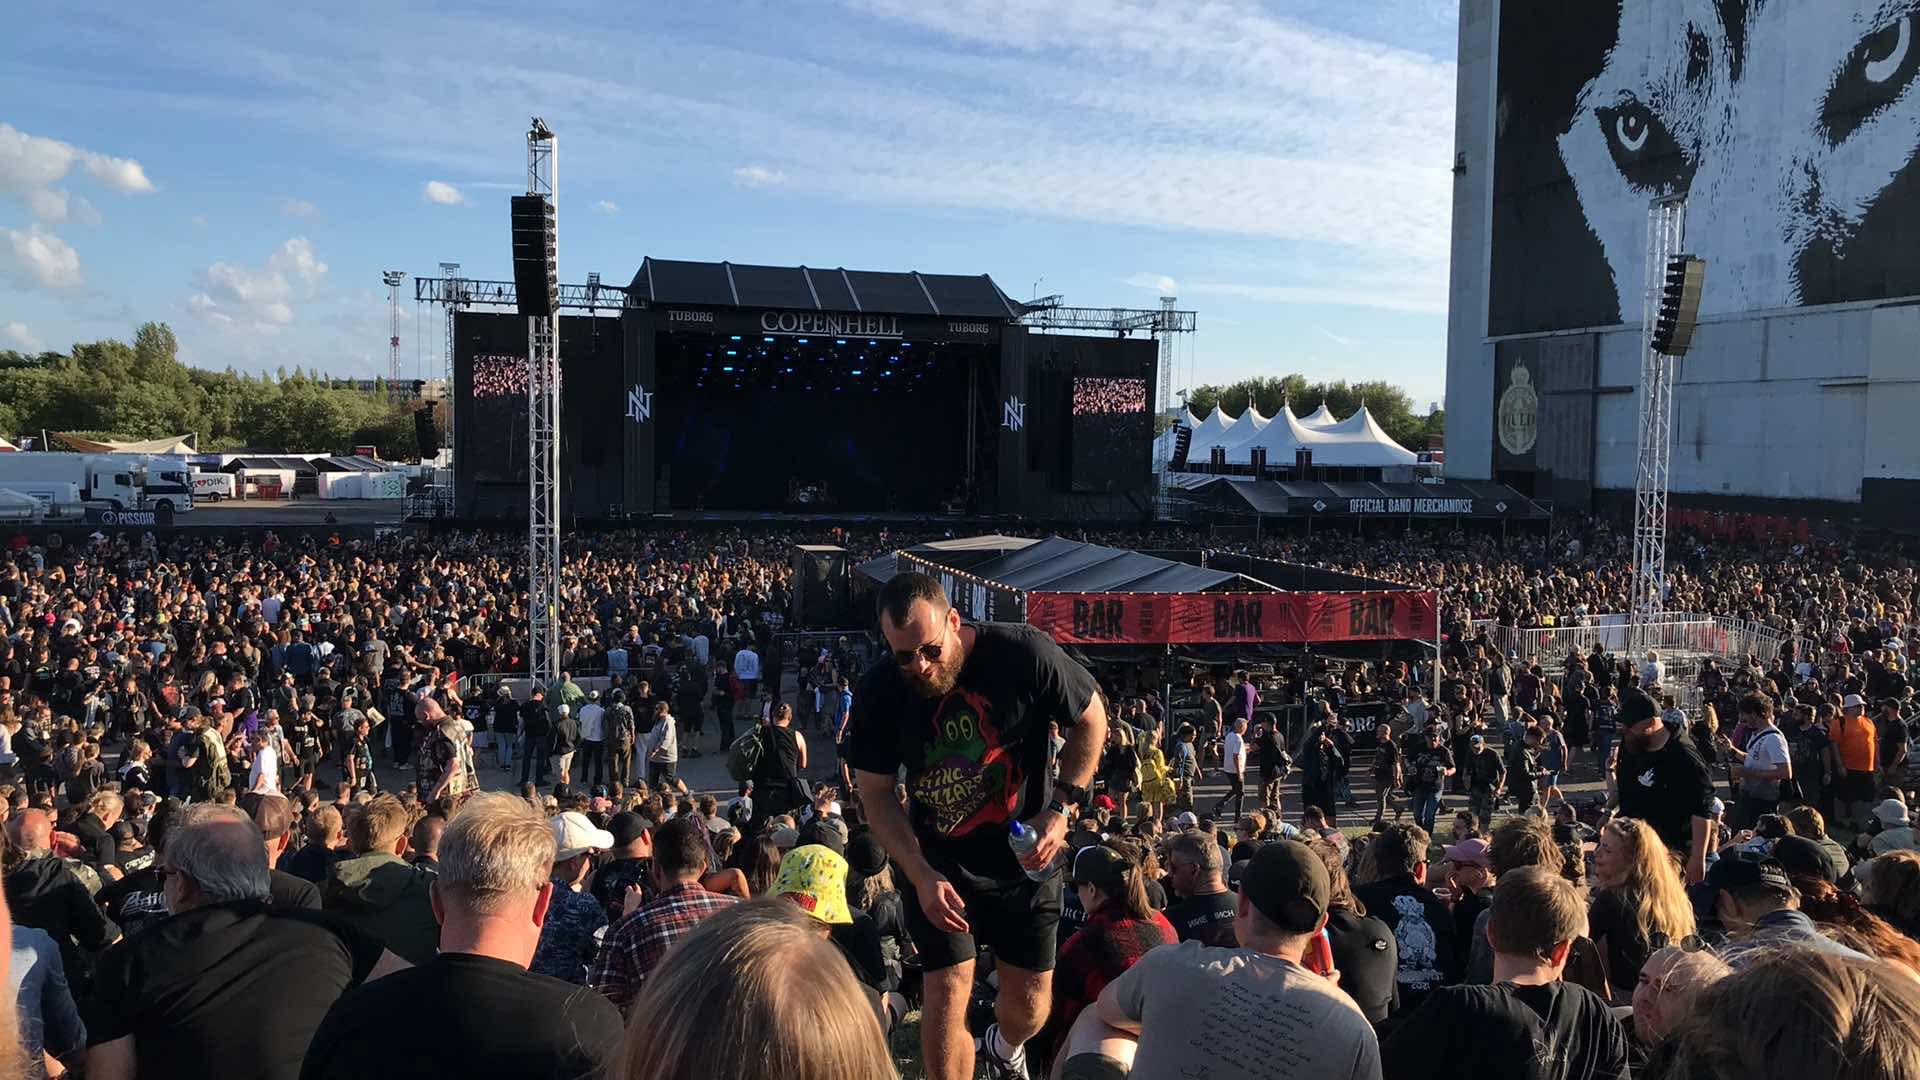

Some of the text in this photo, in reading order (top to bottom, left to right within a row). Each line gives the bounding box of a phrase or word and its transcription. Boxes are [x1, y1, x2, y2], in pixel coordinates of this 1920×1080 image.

[668, 310, 714, 323] TUBORG
[760, 311, 904, 338] COPENHELL
[948, 322, 990, 334] TUBORG
[1349, 498, 1473, 513] OFFICIAL BAND MERCHANDISE
[118, 512, 156, 525] PISSOIR
[1073, 598, 1124, 638] BAR
[1215, 598, 1262, 638] BAR
[1350, 599, 1395, 635] BAR
